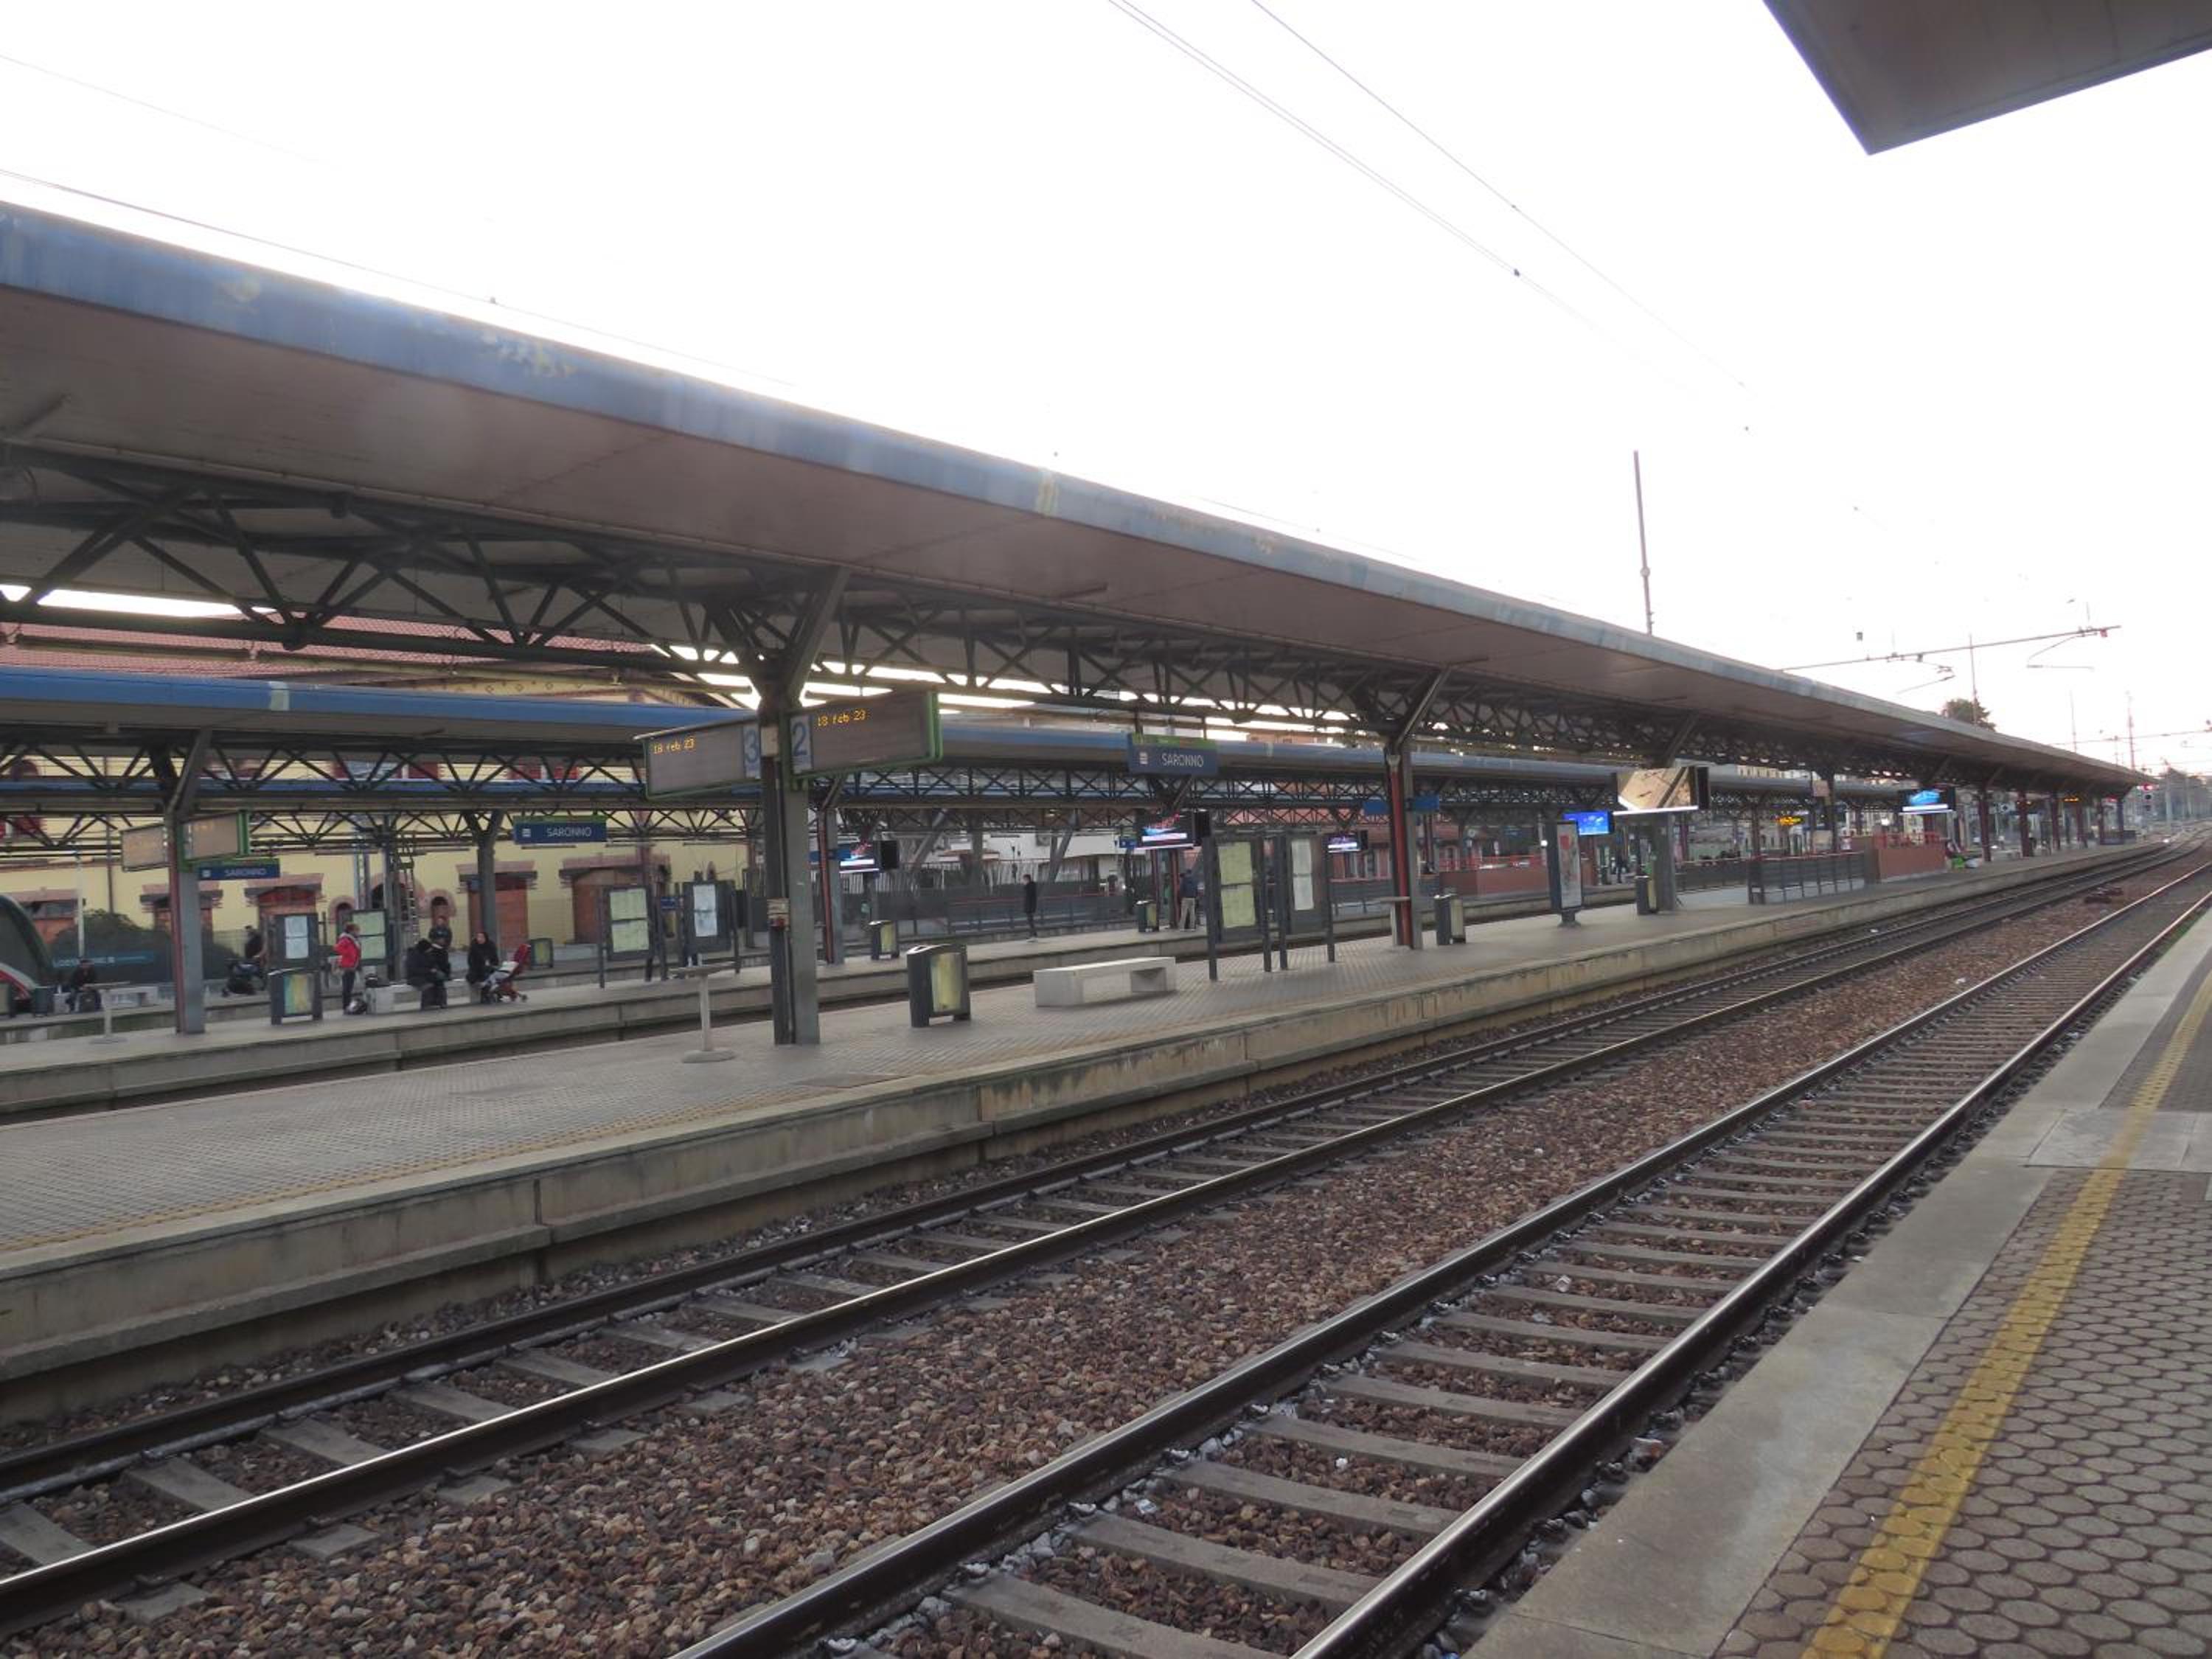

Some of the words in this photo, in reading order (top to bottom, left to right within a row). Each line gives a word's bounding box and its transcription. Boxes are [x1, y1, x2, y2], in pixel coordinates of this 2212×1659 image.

[818, 716, 828, 726] 18
[853, 709, 866, 720] 23
[653, 744, 663, 754] 18
[684, 738, 695, 749] 23
[745, 729, 759, 763] 3
[792, 721, 807, 757] 2
[1161, 752, 1204, 768] SARONNO
[546, 827, 592, 838] SARONNO
